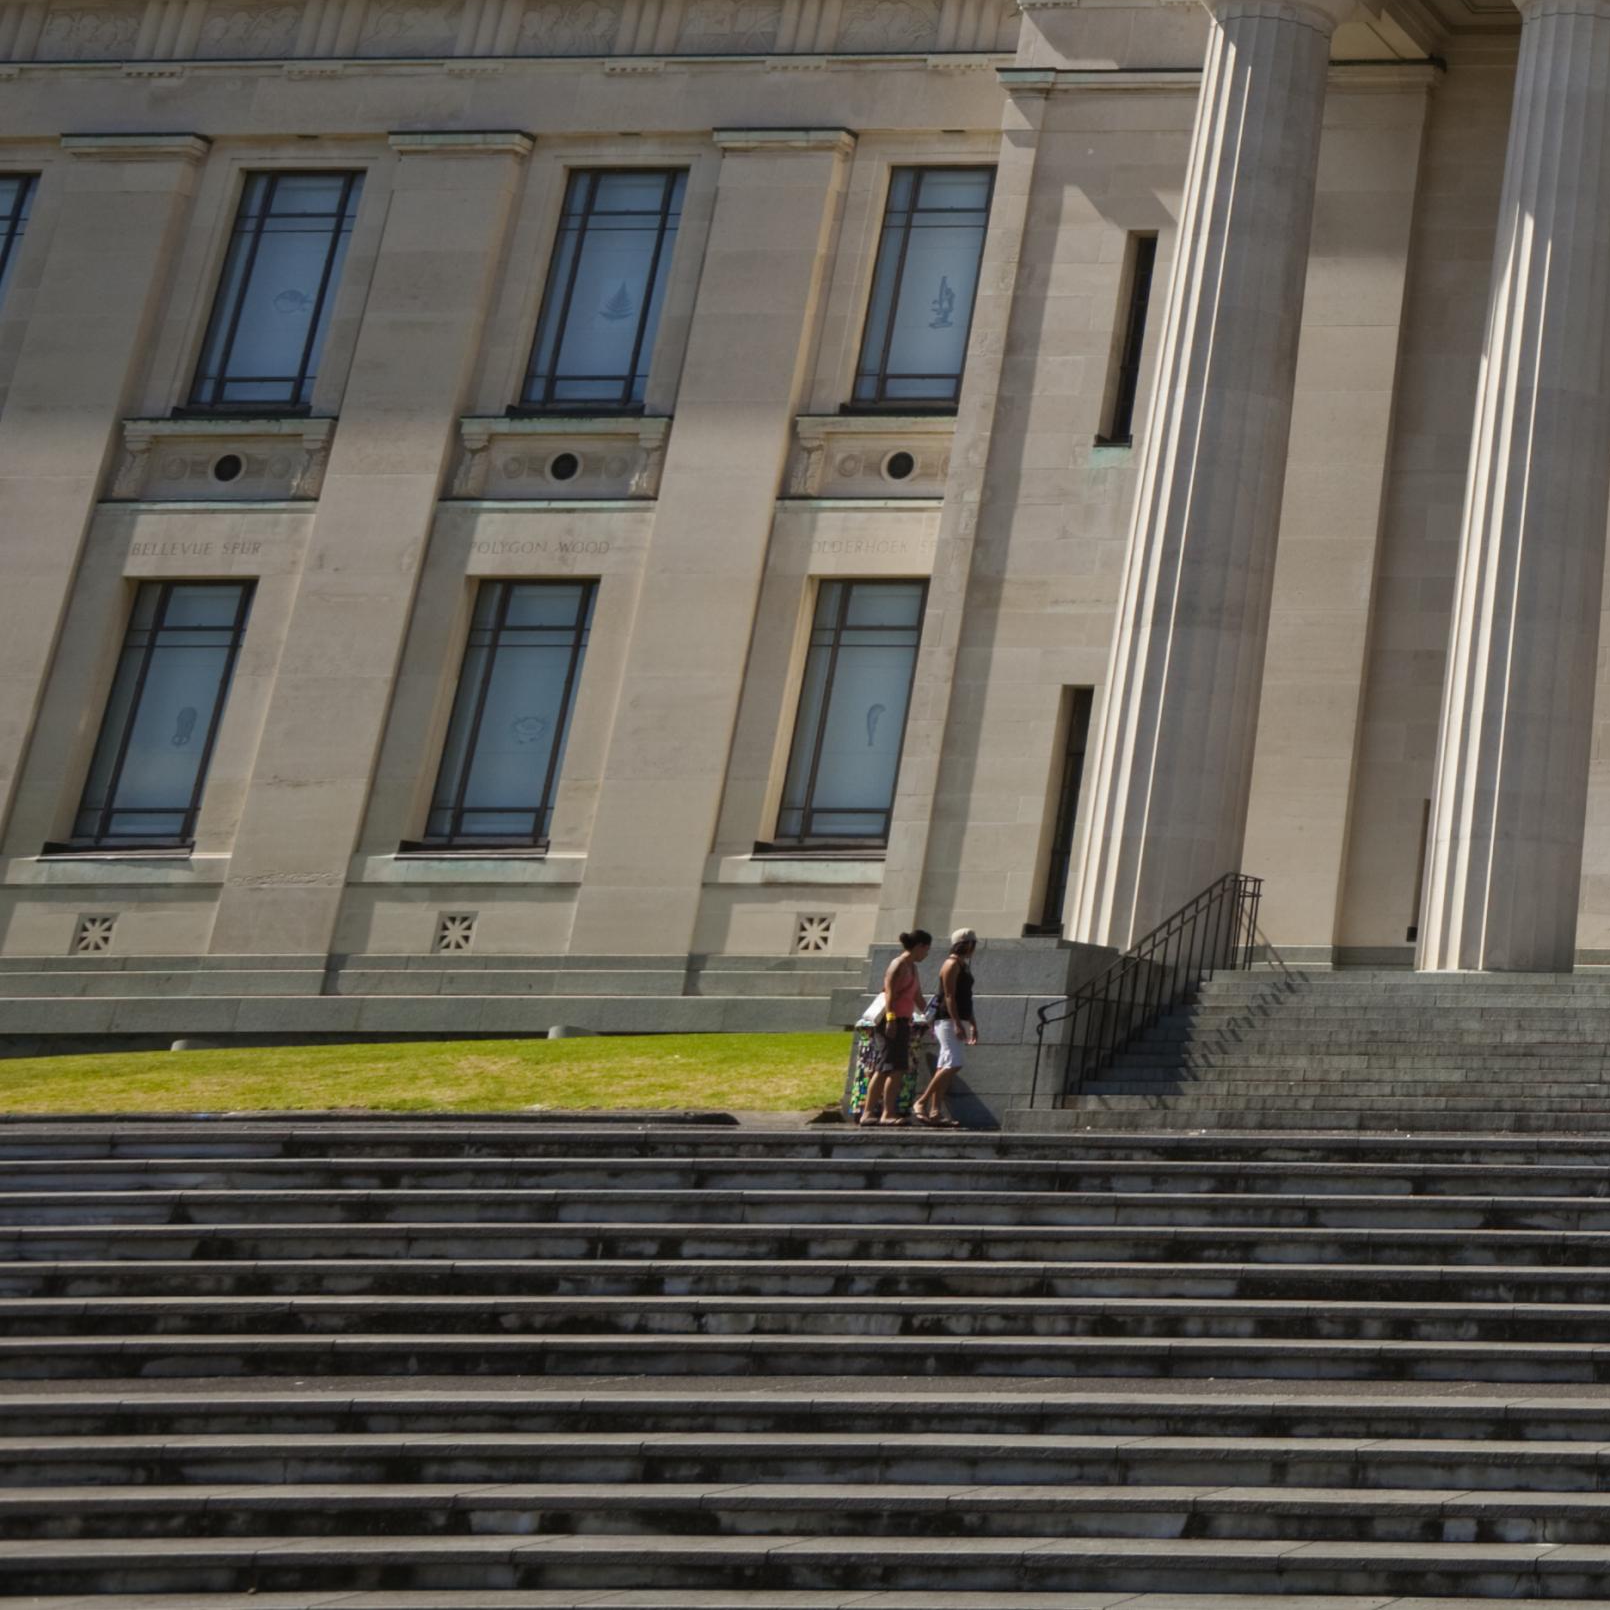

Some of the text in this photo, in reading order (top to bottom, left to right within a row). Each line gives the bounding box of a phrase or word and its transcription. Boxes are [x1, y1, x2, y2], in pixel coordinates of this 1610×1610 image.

[131, 541, 262, 556] BELLEVUE SPUR
[556, 540, 611, 555] WOOD
